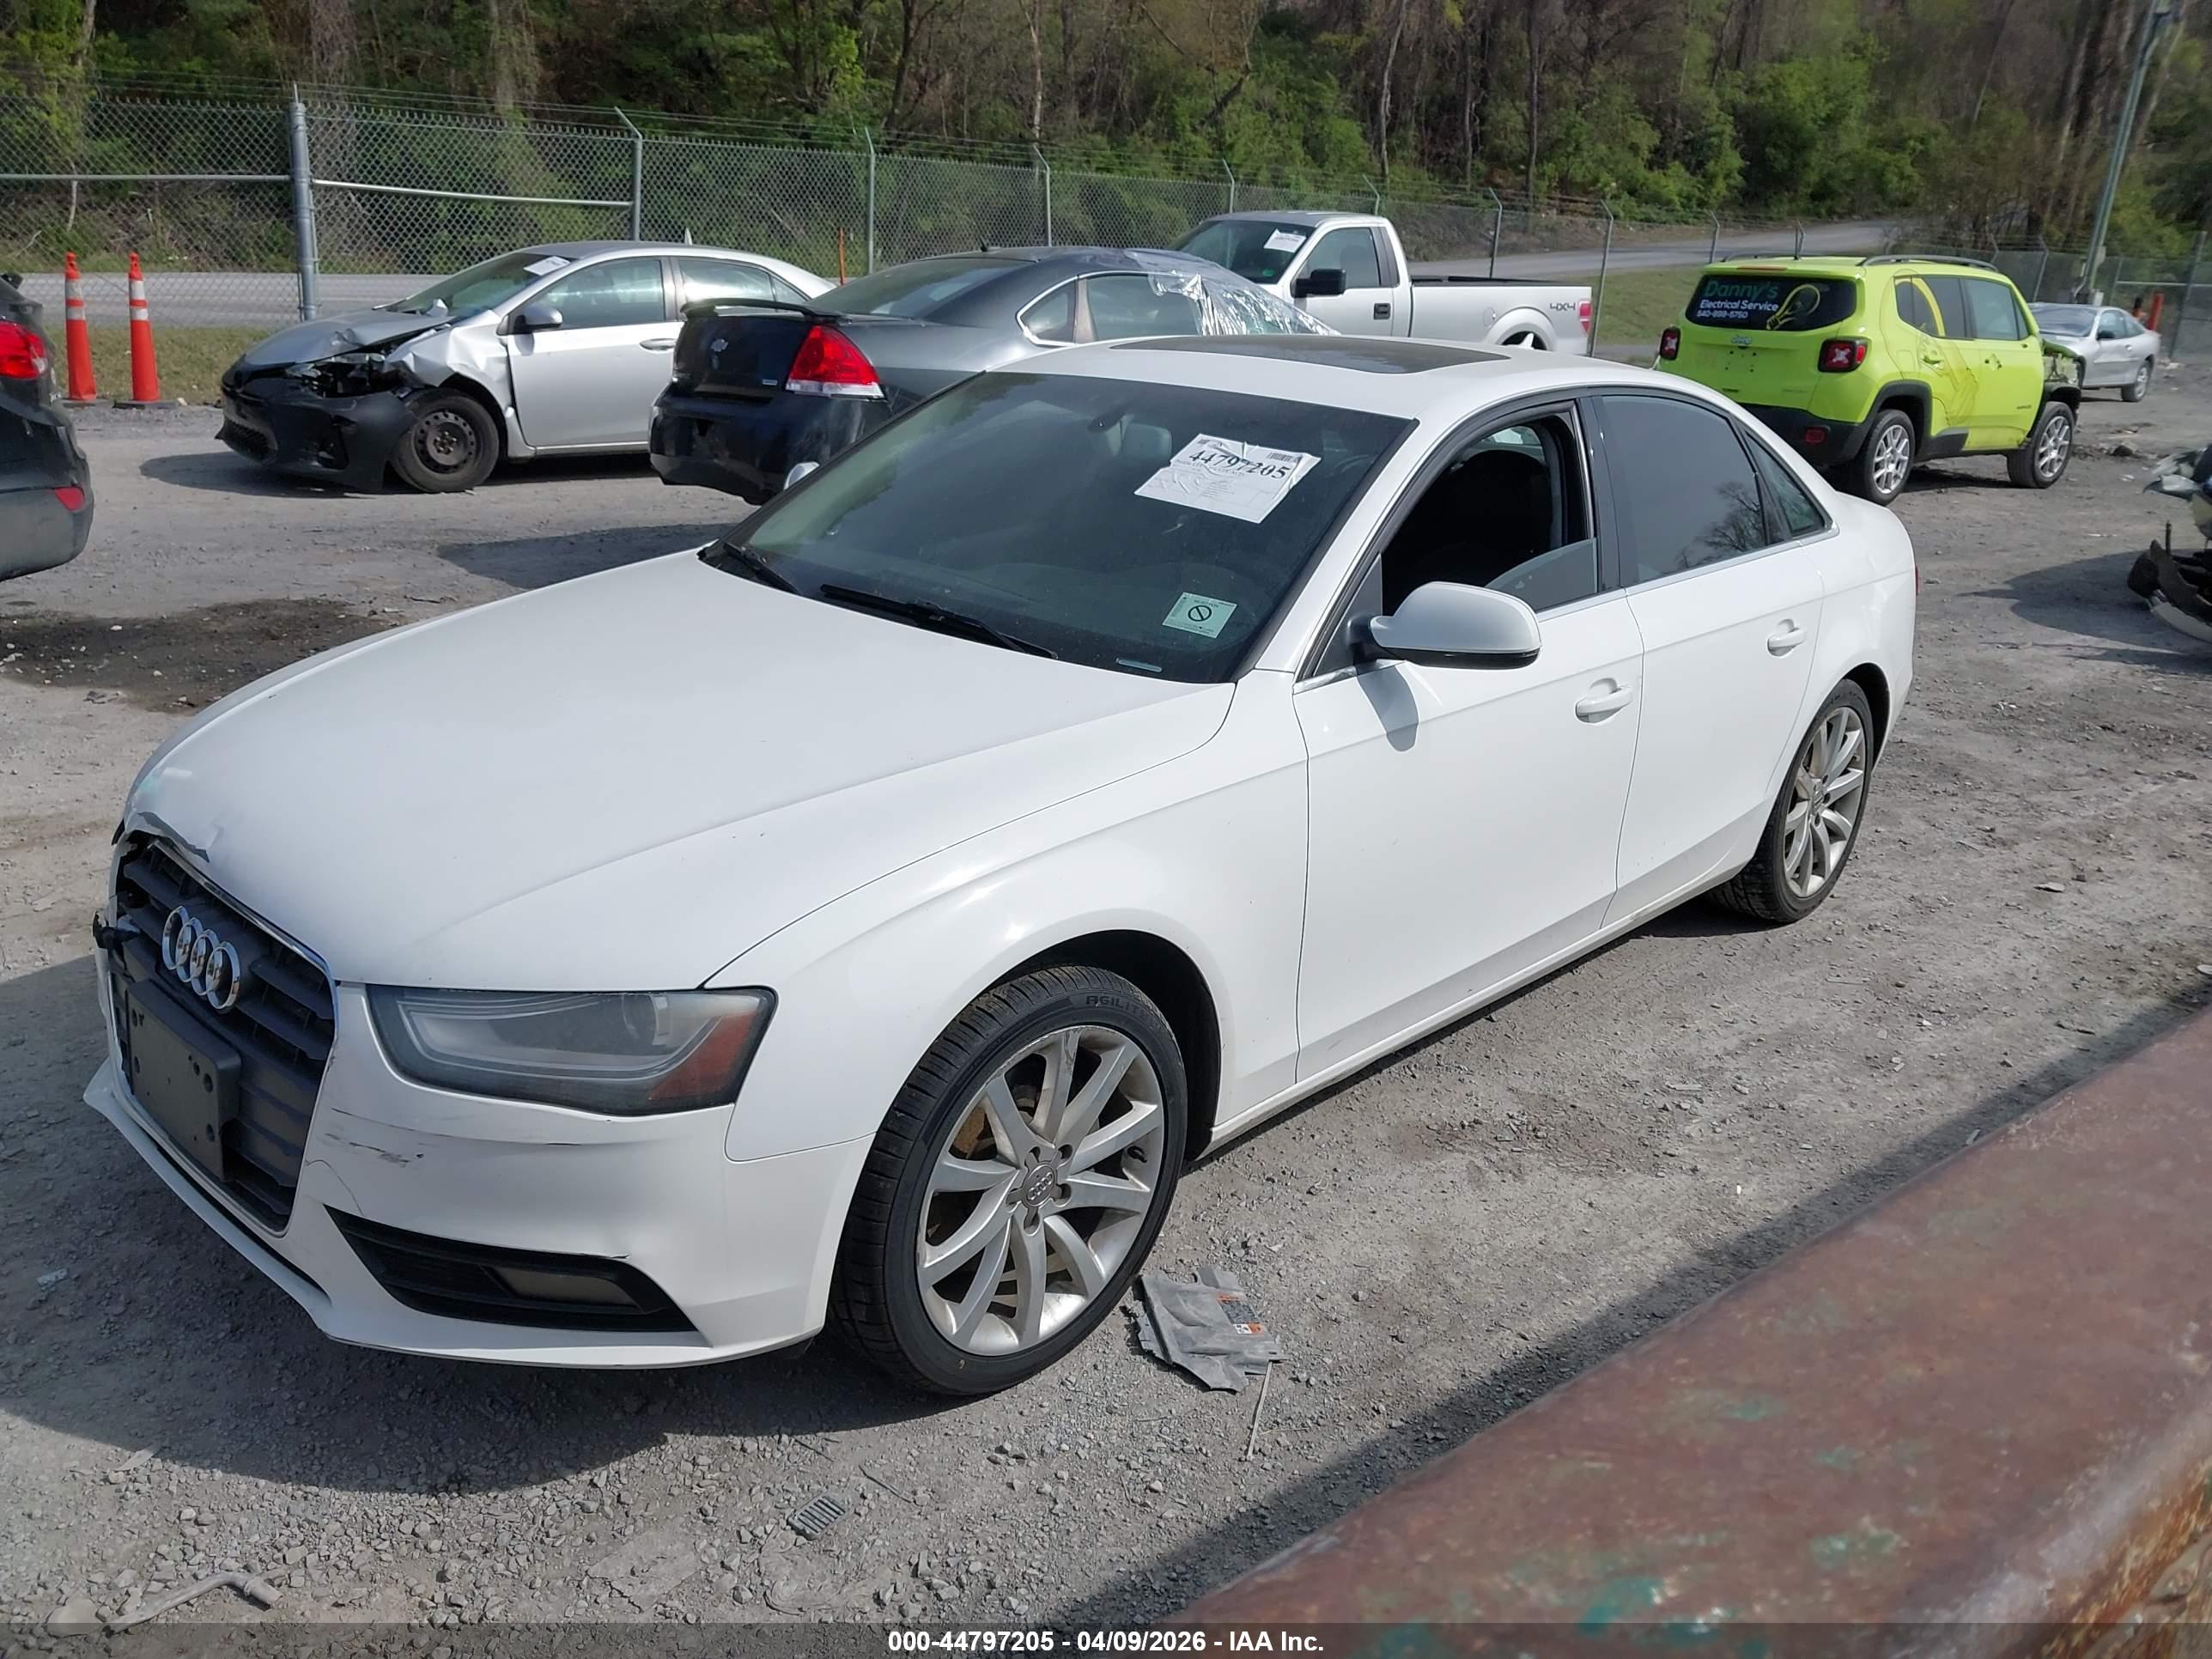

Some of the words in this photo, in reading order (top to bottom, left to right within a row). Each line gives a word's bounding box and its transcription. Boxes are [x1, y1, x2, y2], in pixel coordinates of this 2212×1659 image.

[1705, 281, 1778, 300] Danny's
[1700, 300, 1740, 310] Electrical
[1741, 300, 1778, 311] Service
[1188, 449, 1290, 480] 44797205
